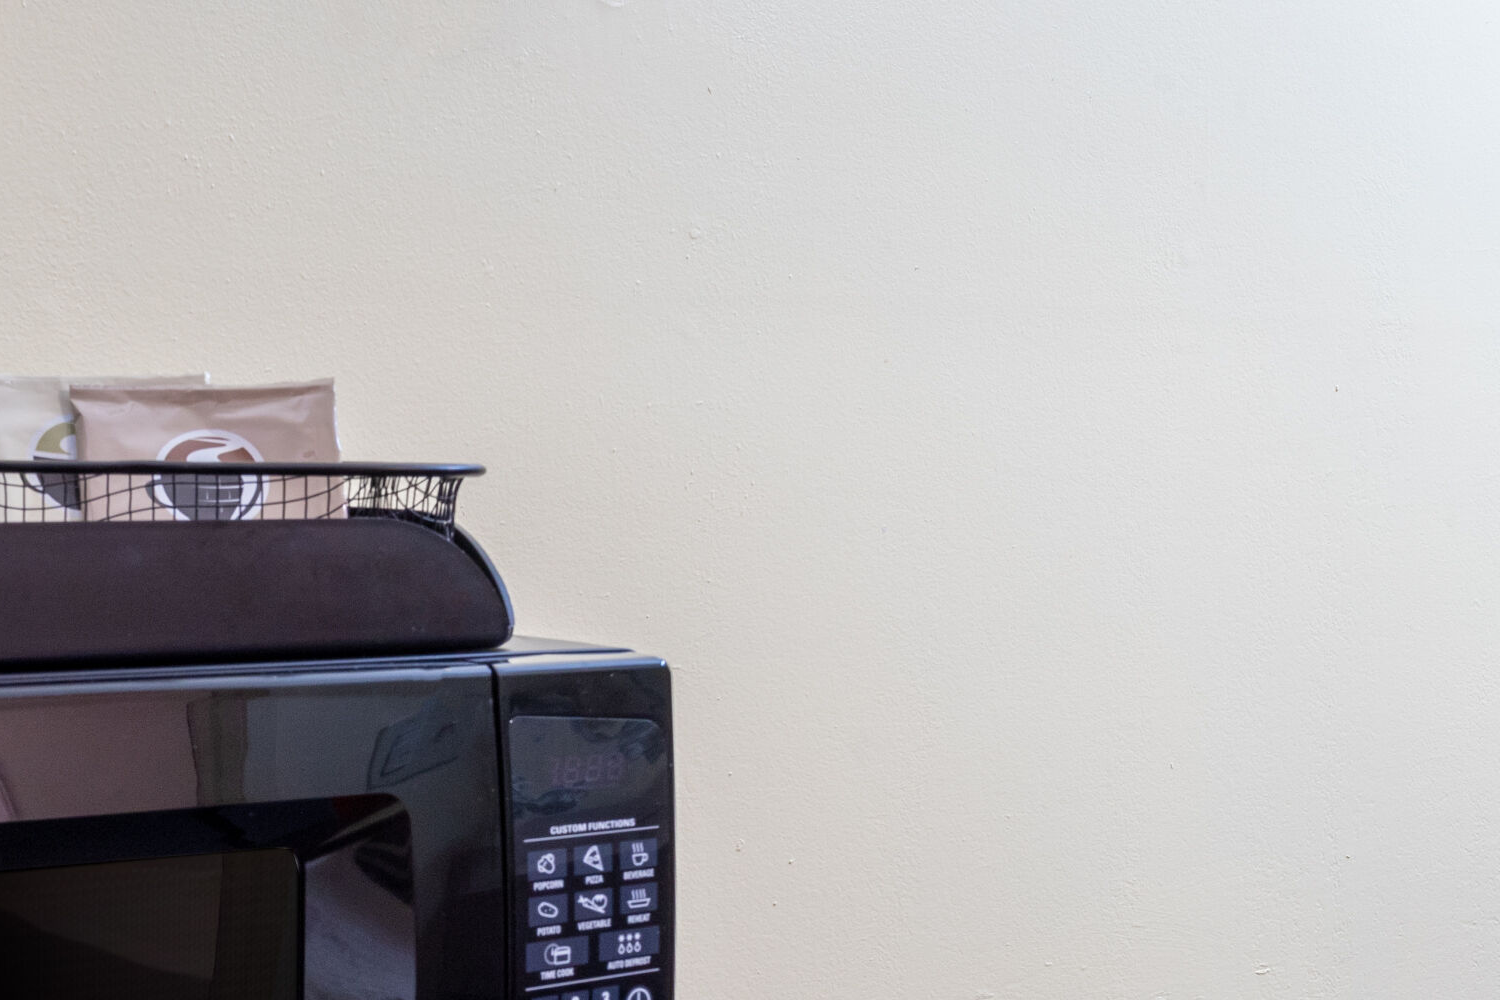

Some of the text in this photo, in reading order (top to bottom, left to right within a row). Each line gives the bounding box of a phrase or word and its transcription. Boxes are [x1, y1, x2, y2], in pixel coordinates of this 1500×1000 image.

[550, 818, 636, 835] CUSTOM FUNCTIONS
[585, 874, 604, 885] PIZZA
[623, 869, 654, 880] BEVERAGE
[533, 880, 564, 891] POPCORN
[627, 913, 651, 924] REHEAT
[577, 918, 611, 931] VEGETABLE
[537, 925, 562, 936] POTATO
[607, 956, 651, 970] AUTO DEFROST
[541, 967, 574, 980] TIME COOK
